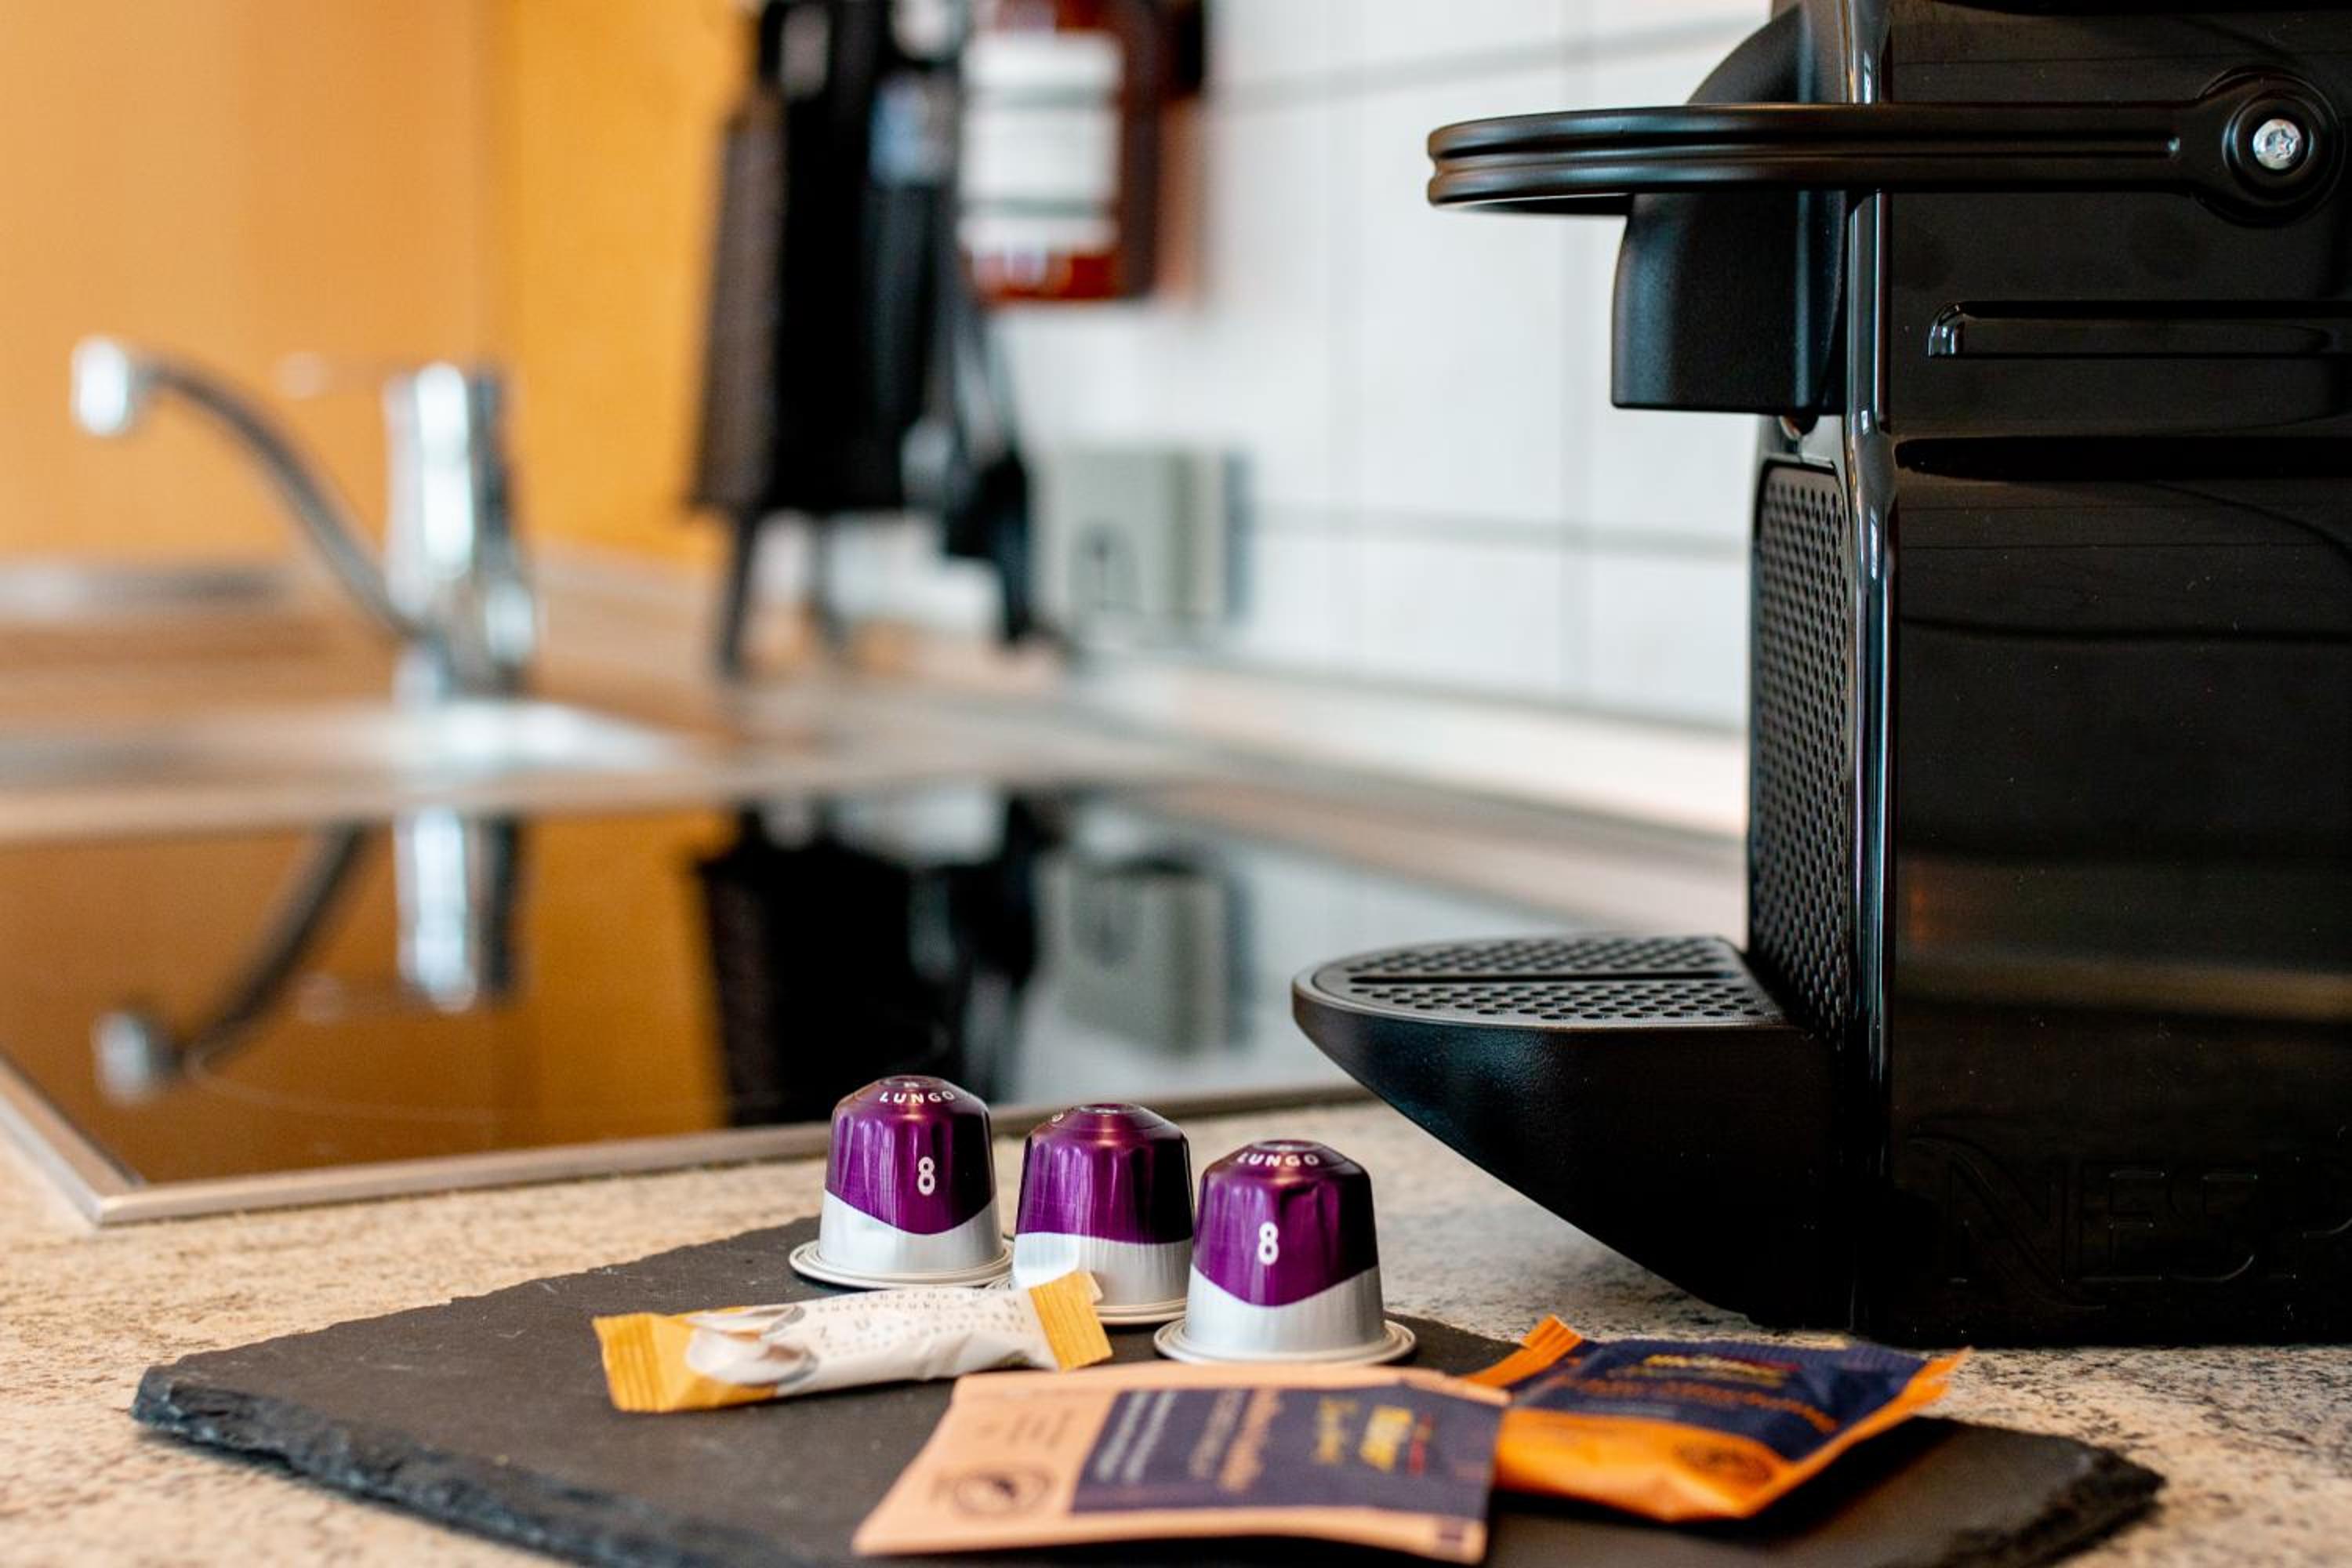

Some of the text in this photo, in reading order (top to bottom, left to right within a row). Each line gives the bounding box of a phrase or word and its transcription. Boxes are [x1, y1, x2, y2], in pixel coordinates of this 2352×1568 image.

[879, 1091, 955, 1104] LUNGO
[1237, 1152, 1319, 1167] LUNGO
[917, 1156, 936, 1196] 8
[1257, 1221, 1279, 1266] 8
